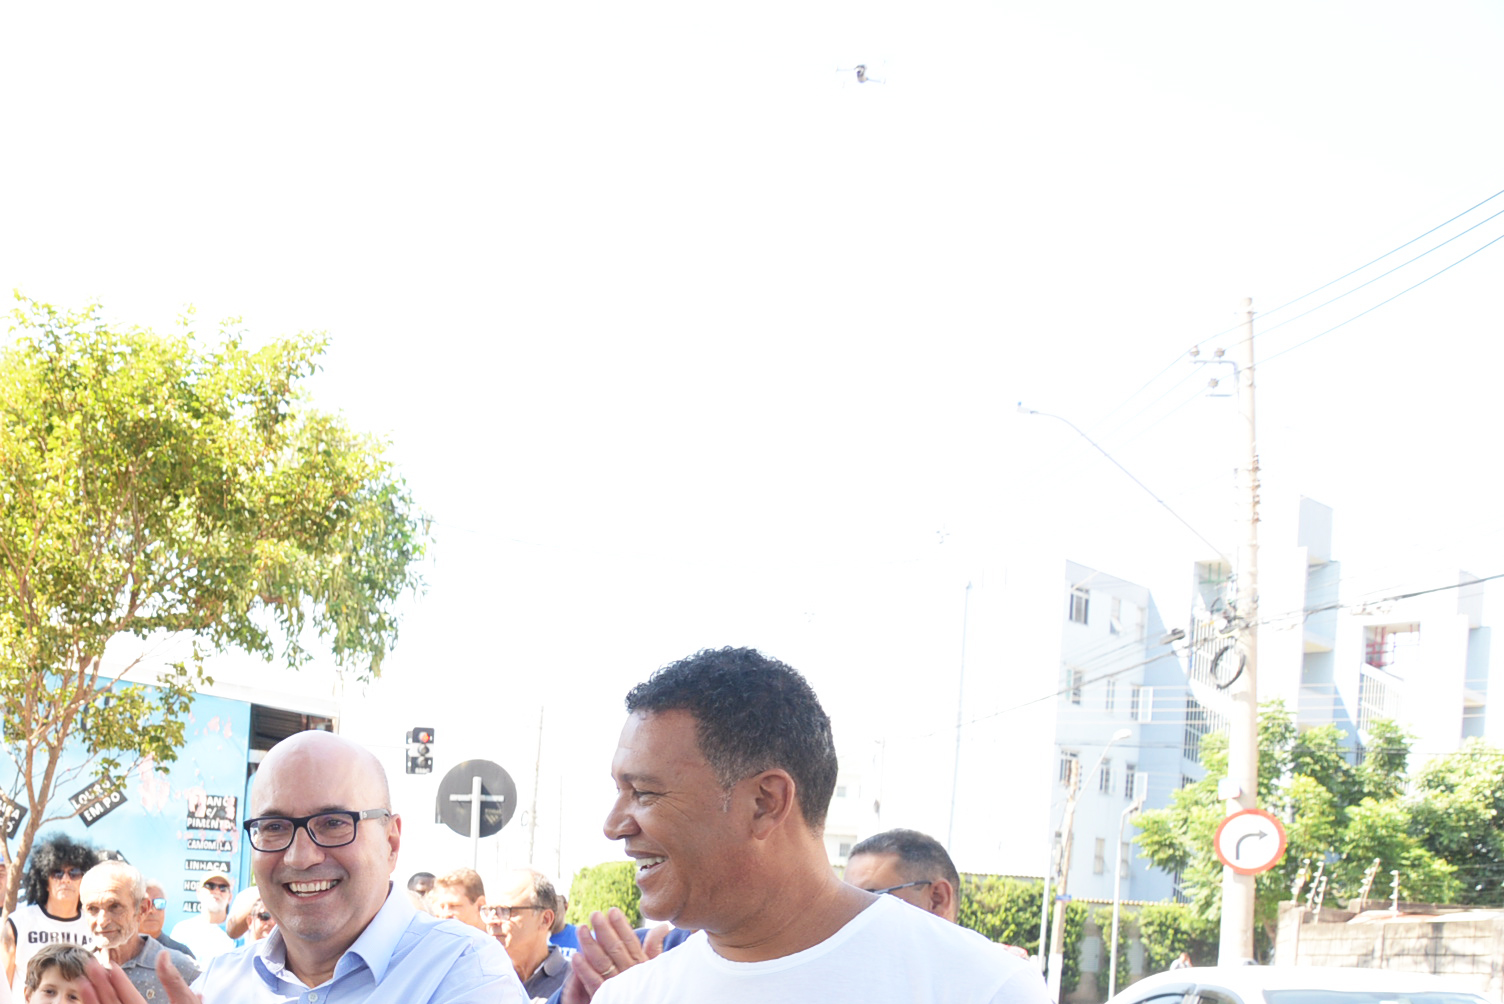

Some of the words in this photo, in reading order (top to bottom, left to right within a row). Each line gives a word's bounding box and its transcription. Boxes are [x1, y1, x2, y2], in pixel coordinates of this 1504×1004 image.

[82, 801, 105, 822] EM
[187, 818, 232, 829] PIMENTA
[187, 840, 231, 850] CAMOMILA
